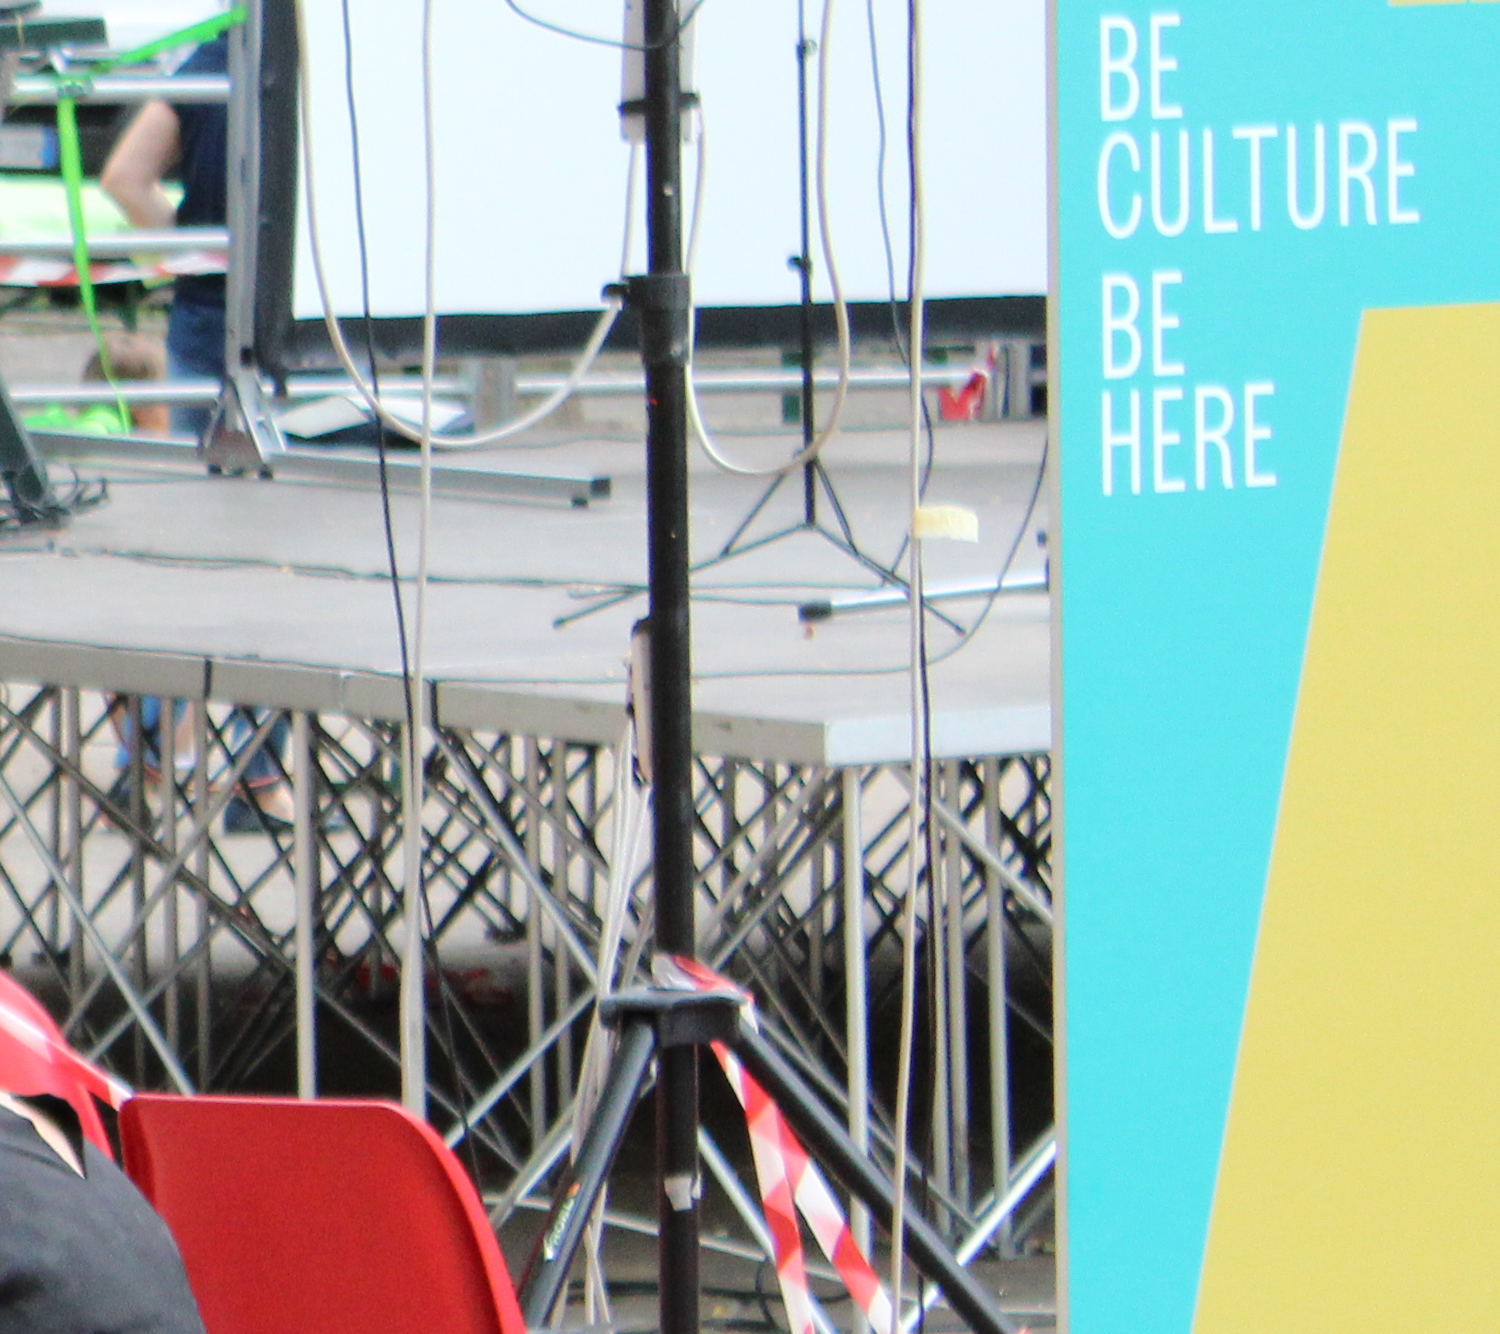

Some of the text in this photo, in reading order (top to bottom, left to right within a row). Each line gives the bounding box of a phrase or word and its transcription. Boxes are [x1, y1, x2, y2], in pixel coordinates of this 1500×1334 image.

[1100, 12, 1183, 122] BE
[1098, 119, 1420, 239] CULTURE
[1100, 269, 1186, 380] BE
[1102, 382, 1277, 496] HERE
